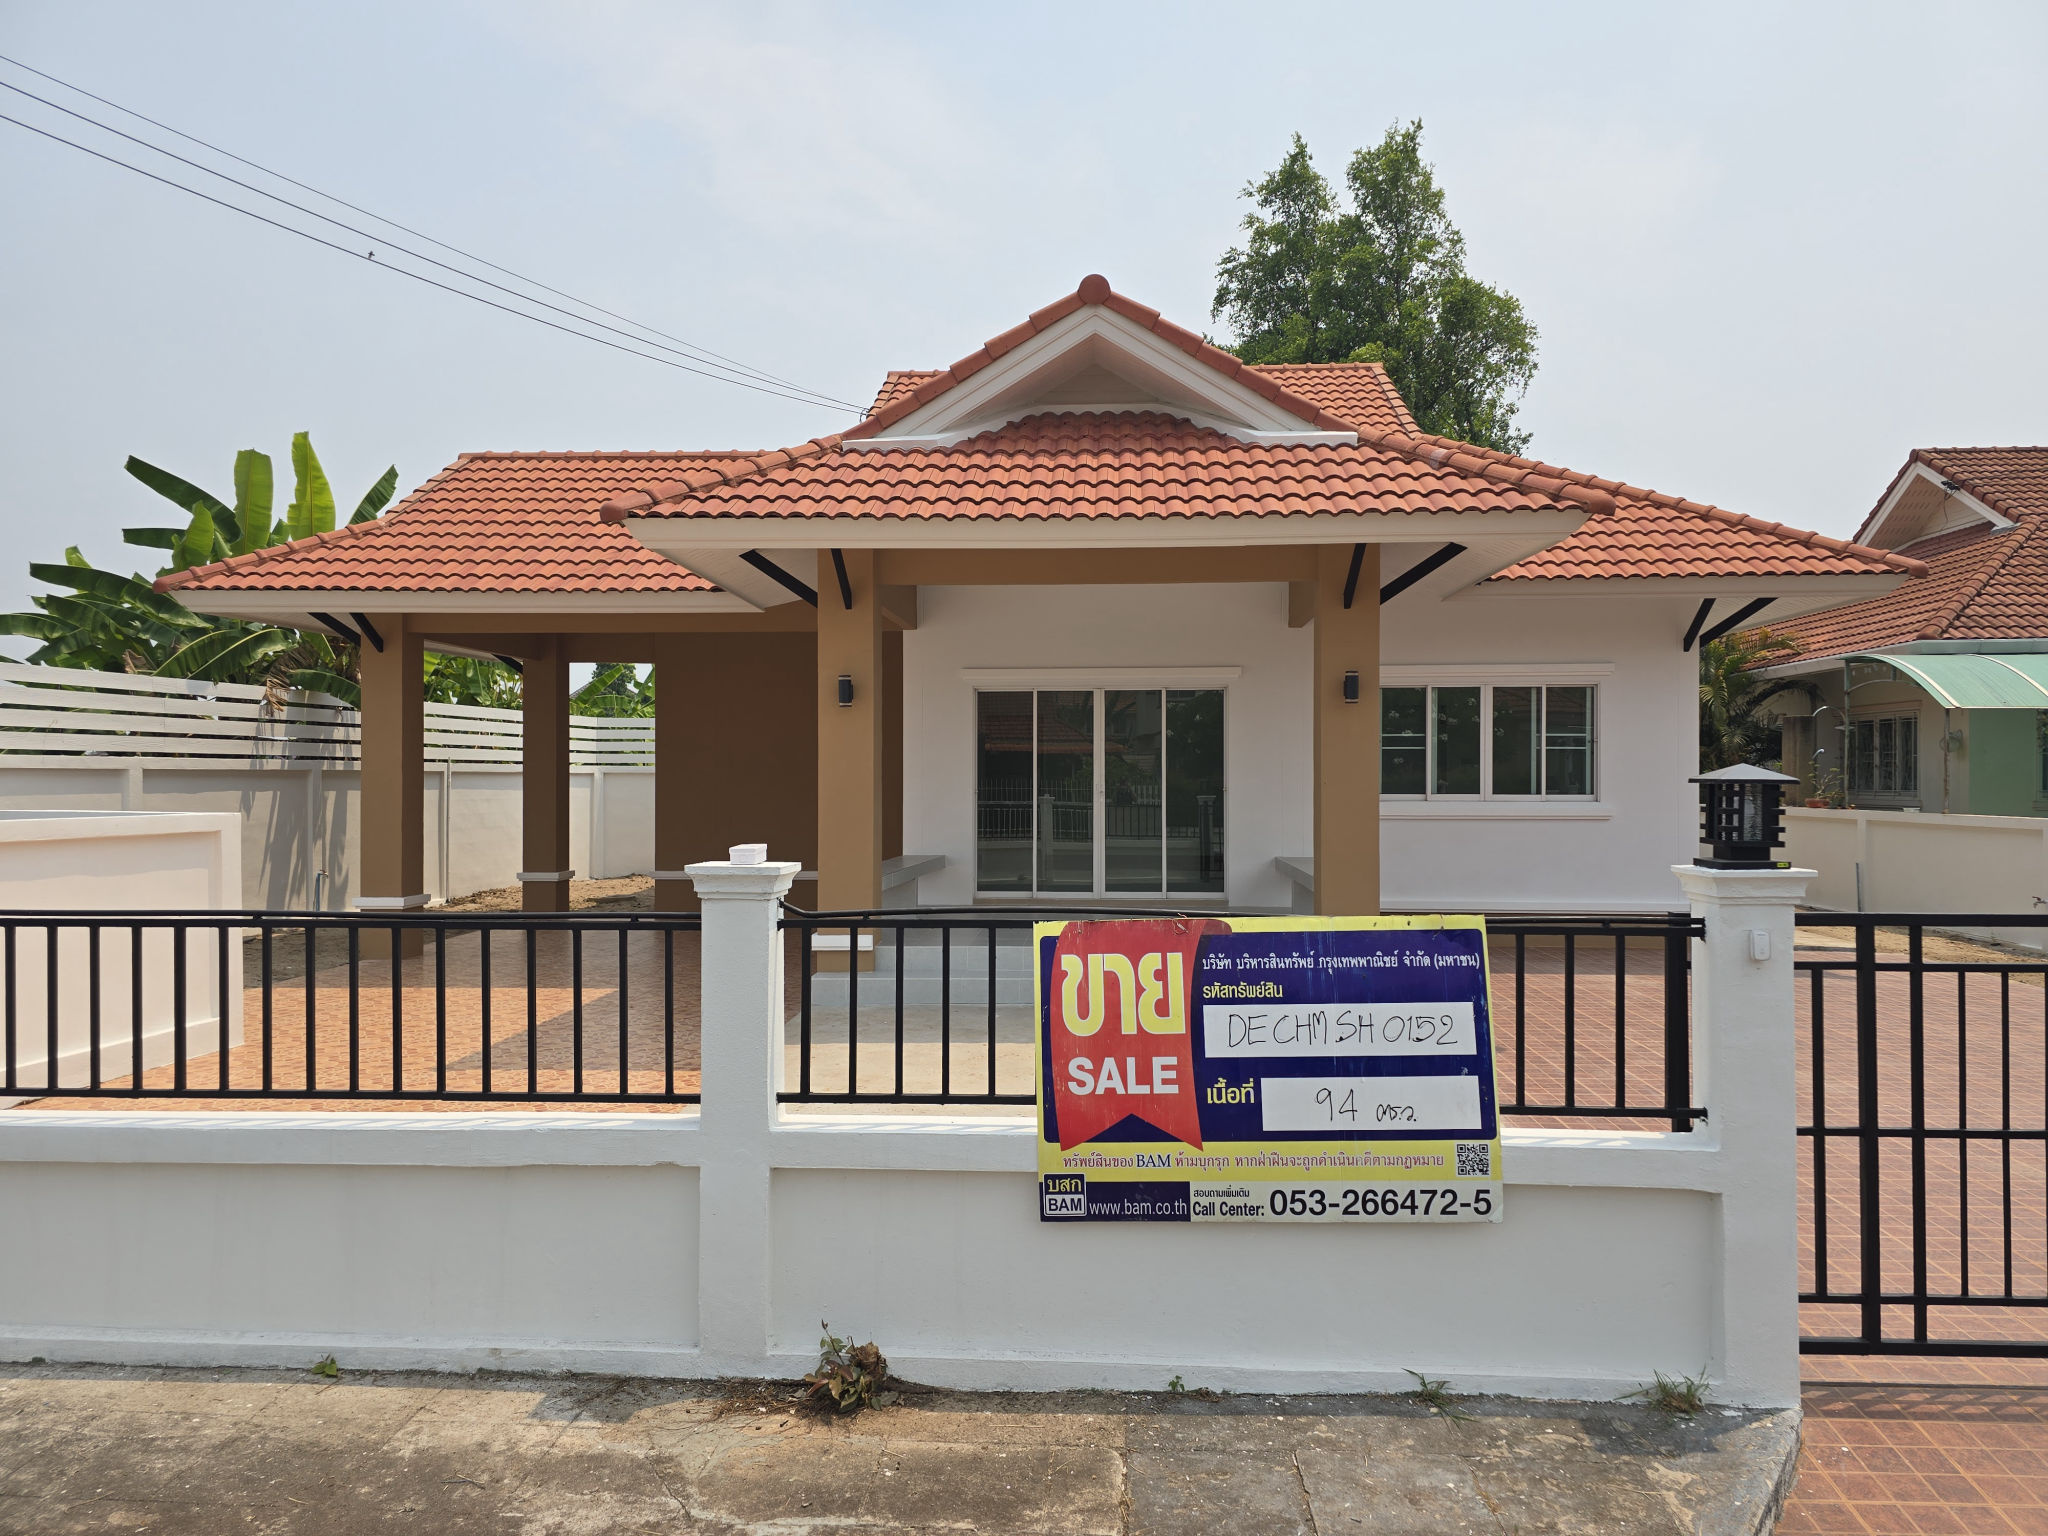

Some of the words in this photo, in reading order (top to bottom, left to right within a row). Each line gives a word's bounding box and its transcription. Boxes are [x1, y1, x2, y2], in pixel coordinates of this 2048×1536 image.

[1202, 953, 1232, 970] บริษัท
[1236, 951, 1315, 970] บริหารสินทรัพย์
[1318, 950, 1399, 975] กรุงเทพพาณิชย์
[1402, 951, 1431, 968] จำกัด
[1434, 953, 1480, 970] (มหาชน)
[1061, 952, 1186, 1036] ขาย
[1202, 981, 1283, 999] รหัสทรัพย์สิน
[1067, 1056, 1179, 1096] SALE
[1206, 1077, 1255, 1104] เนื้อที่
[1315, 1087, 1358, 1122] 94
[1063, 1152, 1134, 1169] ทรัพย์สินของ
[1136, 1153, 1172, 1168] BAM
[1174, 1151, 1230, 1172] ห้ามบุกรุก
[1048, 1177, 1082, 1193] บสก
[1193, 1184, 1250, 1198] สอบถามเพิ่มเติม
[1049, 1197, 1083, 1213] BAM
[1089, 1199, 1188, 1216] www.bam.co.th
[1192, 1201, 1216, 1216] Call
[1219, 1201, 1265, 1216] Center:
[1269, 1189, 1492, 1216] 053-266472-5
